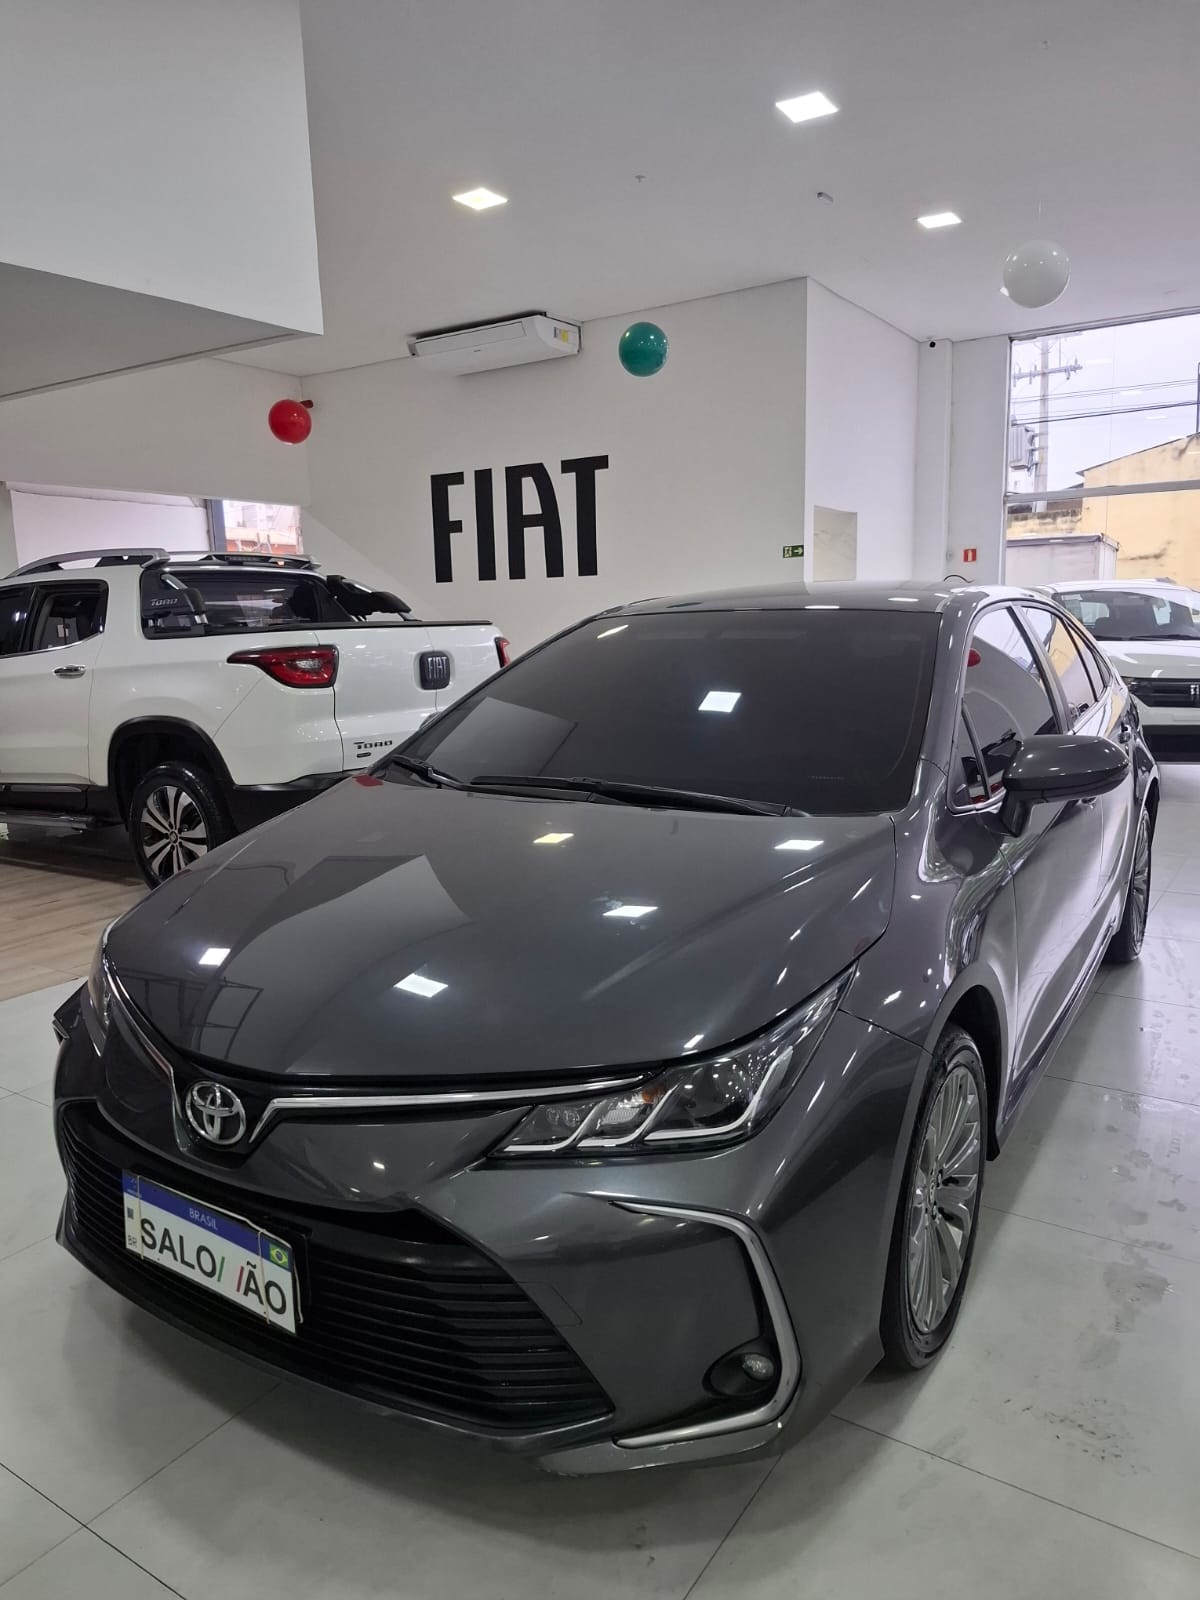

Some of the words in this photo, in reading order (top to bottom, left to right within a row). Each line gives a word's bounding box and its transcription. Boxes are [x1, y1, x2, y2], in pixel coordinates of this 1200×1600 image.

[431, 455, 609, 583] FIAT
[427, 656, 448, 680] FIAT
[353, 740, 393, 750] TORO
[188, 1207, 219, 1231] BRASIL
